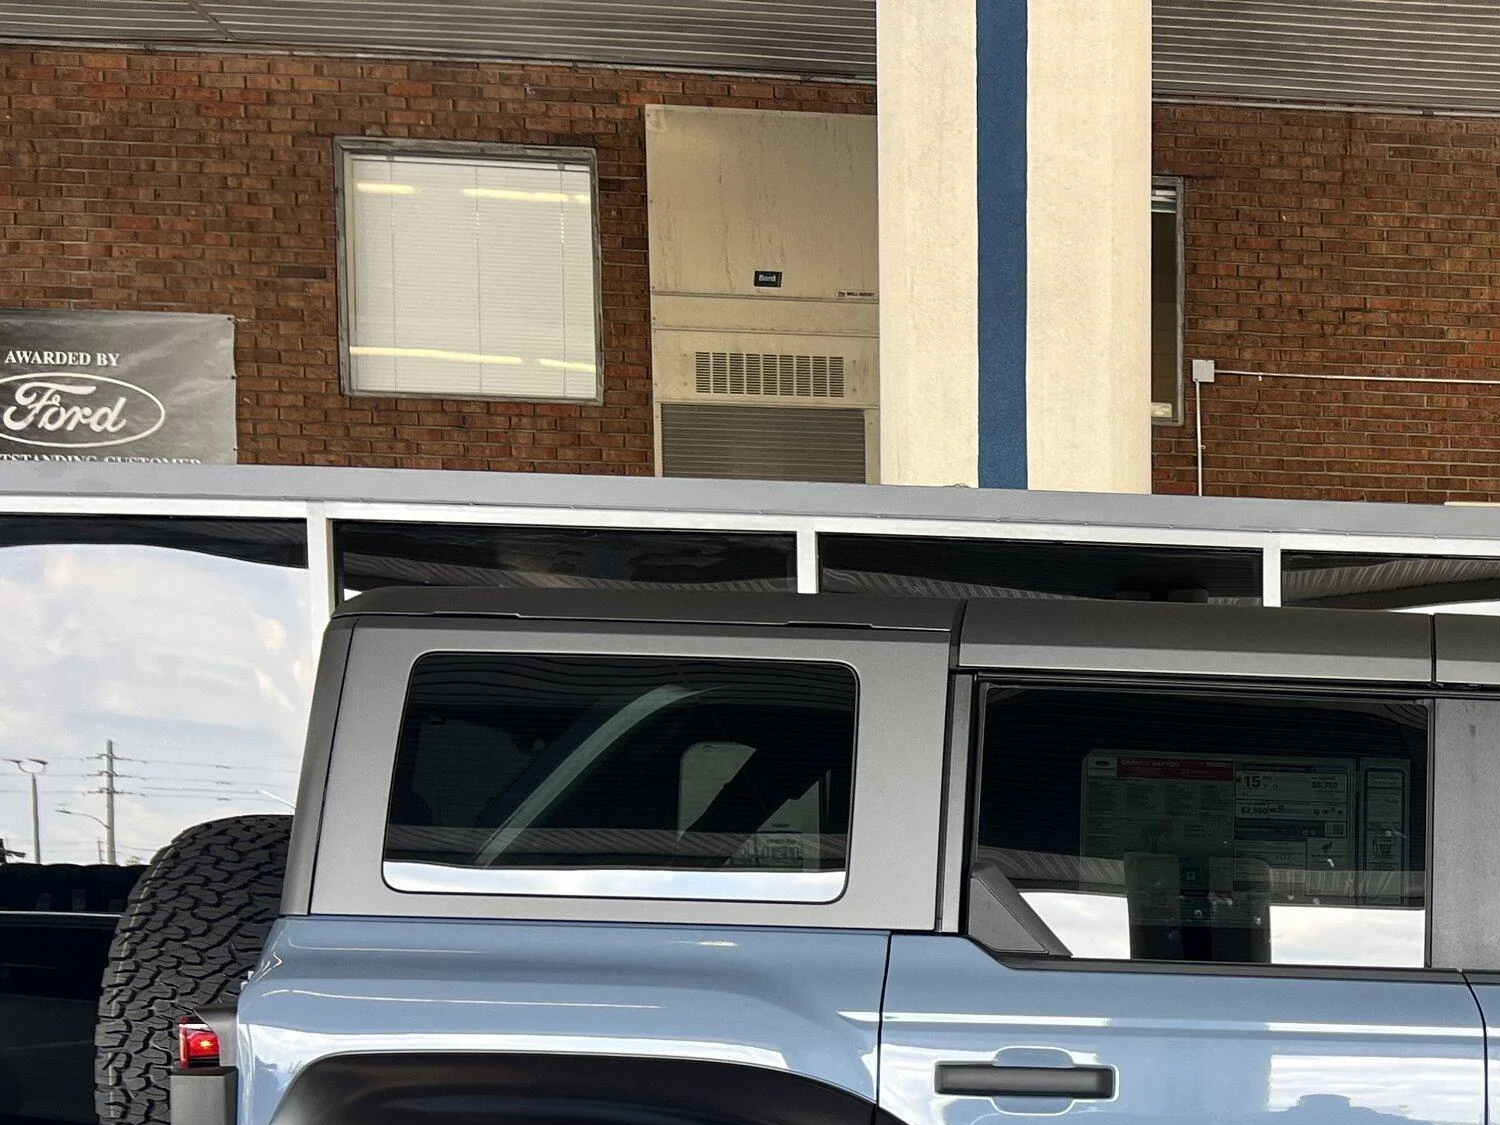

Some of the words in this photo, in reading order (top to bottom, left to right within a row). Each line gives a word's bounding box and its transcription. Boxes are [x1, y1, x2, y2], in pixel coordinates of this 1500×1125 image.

[758, 274, 777, 282] Bard
[4, 350, 91, 366] AWARDED
[96, 352, 120, 367] BY
[3, 381, 127, 433] Ford
[1244, 776, 1260, 787] 15
